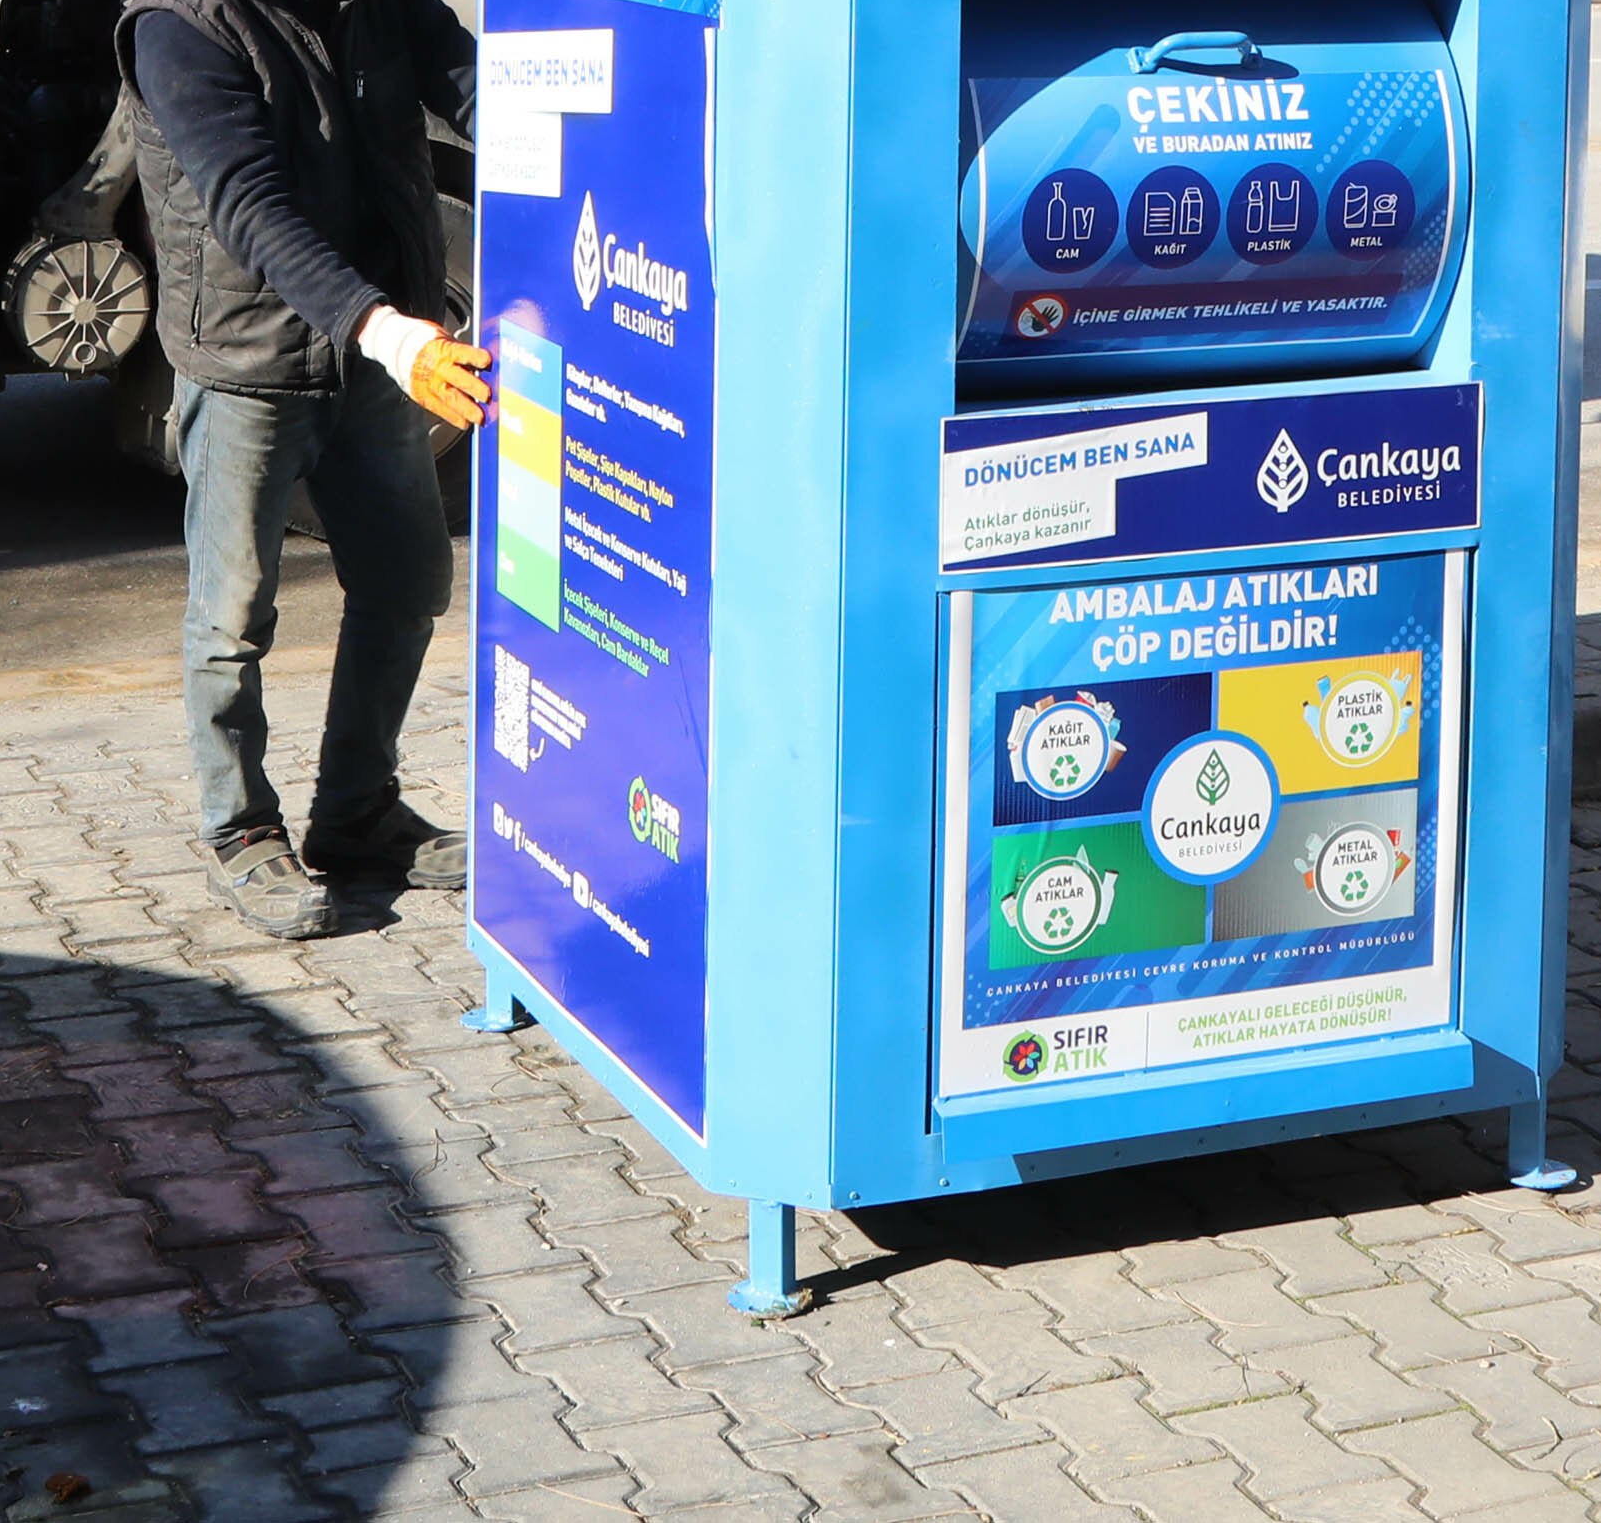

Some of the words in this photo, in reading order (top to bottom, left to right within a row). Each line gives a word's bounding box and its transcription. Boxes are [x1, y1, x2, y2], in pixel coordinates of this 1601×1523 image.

[1127, 77, 1310, 133] ÇEKİNİZ
[1133, 136, 1158, 154] VE
[1162, 134, 1250, 154] BURADAN
[1254, 132, 1313, 151] ATINIZ
[1055, 248, 1080, 259] CAM
[1154, 241, 1186, 256] KAĞIT
[1247, 238, 1291, 252] PLASTİK
[1350, 236, 1383, 248] METAL
[603, 233, 688, 316] Çankaya
[612, 301, 675, 348] BELEDİYESİ
[1072, 307, 1118, 328] İÇİNE
[1124, 304, 1188, 323] GİRMEK
[1194, 299, 1278, 320] TEHLİKELİ
[1282, 300, 1303, 314] VE
[1307, 296, 1389, 312] YASAKTIR.
[964, 454, 1077, 487] DÖNÜCEM
[1084, 442, 1129, 468] BEN
[1135, 431, 1196, 458] SANA
[1317, 442, 1461, 487] Çankaya
[1338, 480, 1442, 509] BELEDİYESİ
[964, 512, 1018, 532] Atıklar
[1022, 499, 1091, 526] dönüşür,
[964, 527, 1030, 552] Çankaya
[1034, 518, 1092, 541] kazanır
[1049, 580, 1216, 624] AMBALAJ
[1224, 564, 1379, 609] ATIKLARI
[1092, 626, 1161, 671] ÇÖP
[1170, 609, 1339, 662] DEĞİLDİR!
[1337, 689, 1383, 706] PLASTİK
[1337, 704, 1383, 719] ATIKLAR
[1048, 719, 1083, 736] KAĞIT
[1040, 735, 1091, 749] ATIKLAR
[651, 821, 680, 864] ATIK
[1179, 839, 1243, 858] BELEDİYESİ
[1337, 839, 1374, 853] METAL
[1331, 851, 1378, 867] ATIKLAR
[1035, 887, 1084, 902] ATIKLAR
[1048, 875, 1073, 888] CAM
[1193, 955, 1246, 970] KORUMA
[1253, 951, 1268, 963] VE
[1275, 944, 1333, 959] KONTROL
[1339, 930, 1416, 951] MÜDÜRLÜĞÜ
[1178, 1007, 1261, 1033] ÇANKAYALI
[1265, 994, 1334, 1020] GELECEĞİ
[1337, 988, 1407, 1010] DÜŞÜNÜR,
[1054, 1025, 1109, 1050] SIFIR
[1193, 1025, 1255, 1049] ATIKLAR
[1259, 1020, 1316, 1040] HAYATA
[1320, 1008, 1392, 1031] DÖNÜŞÜR!
[1053, 1047, 1109, 1073] ATIK
